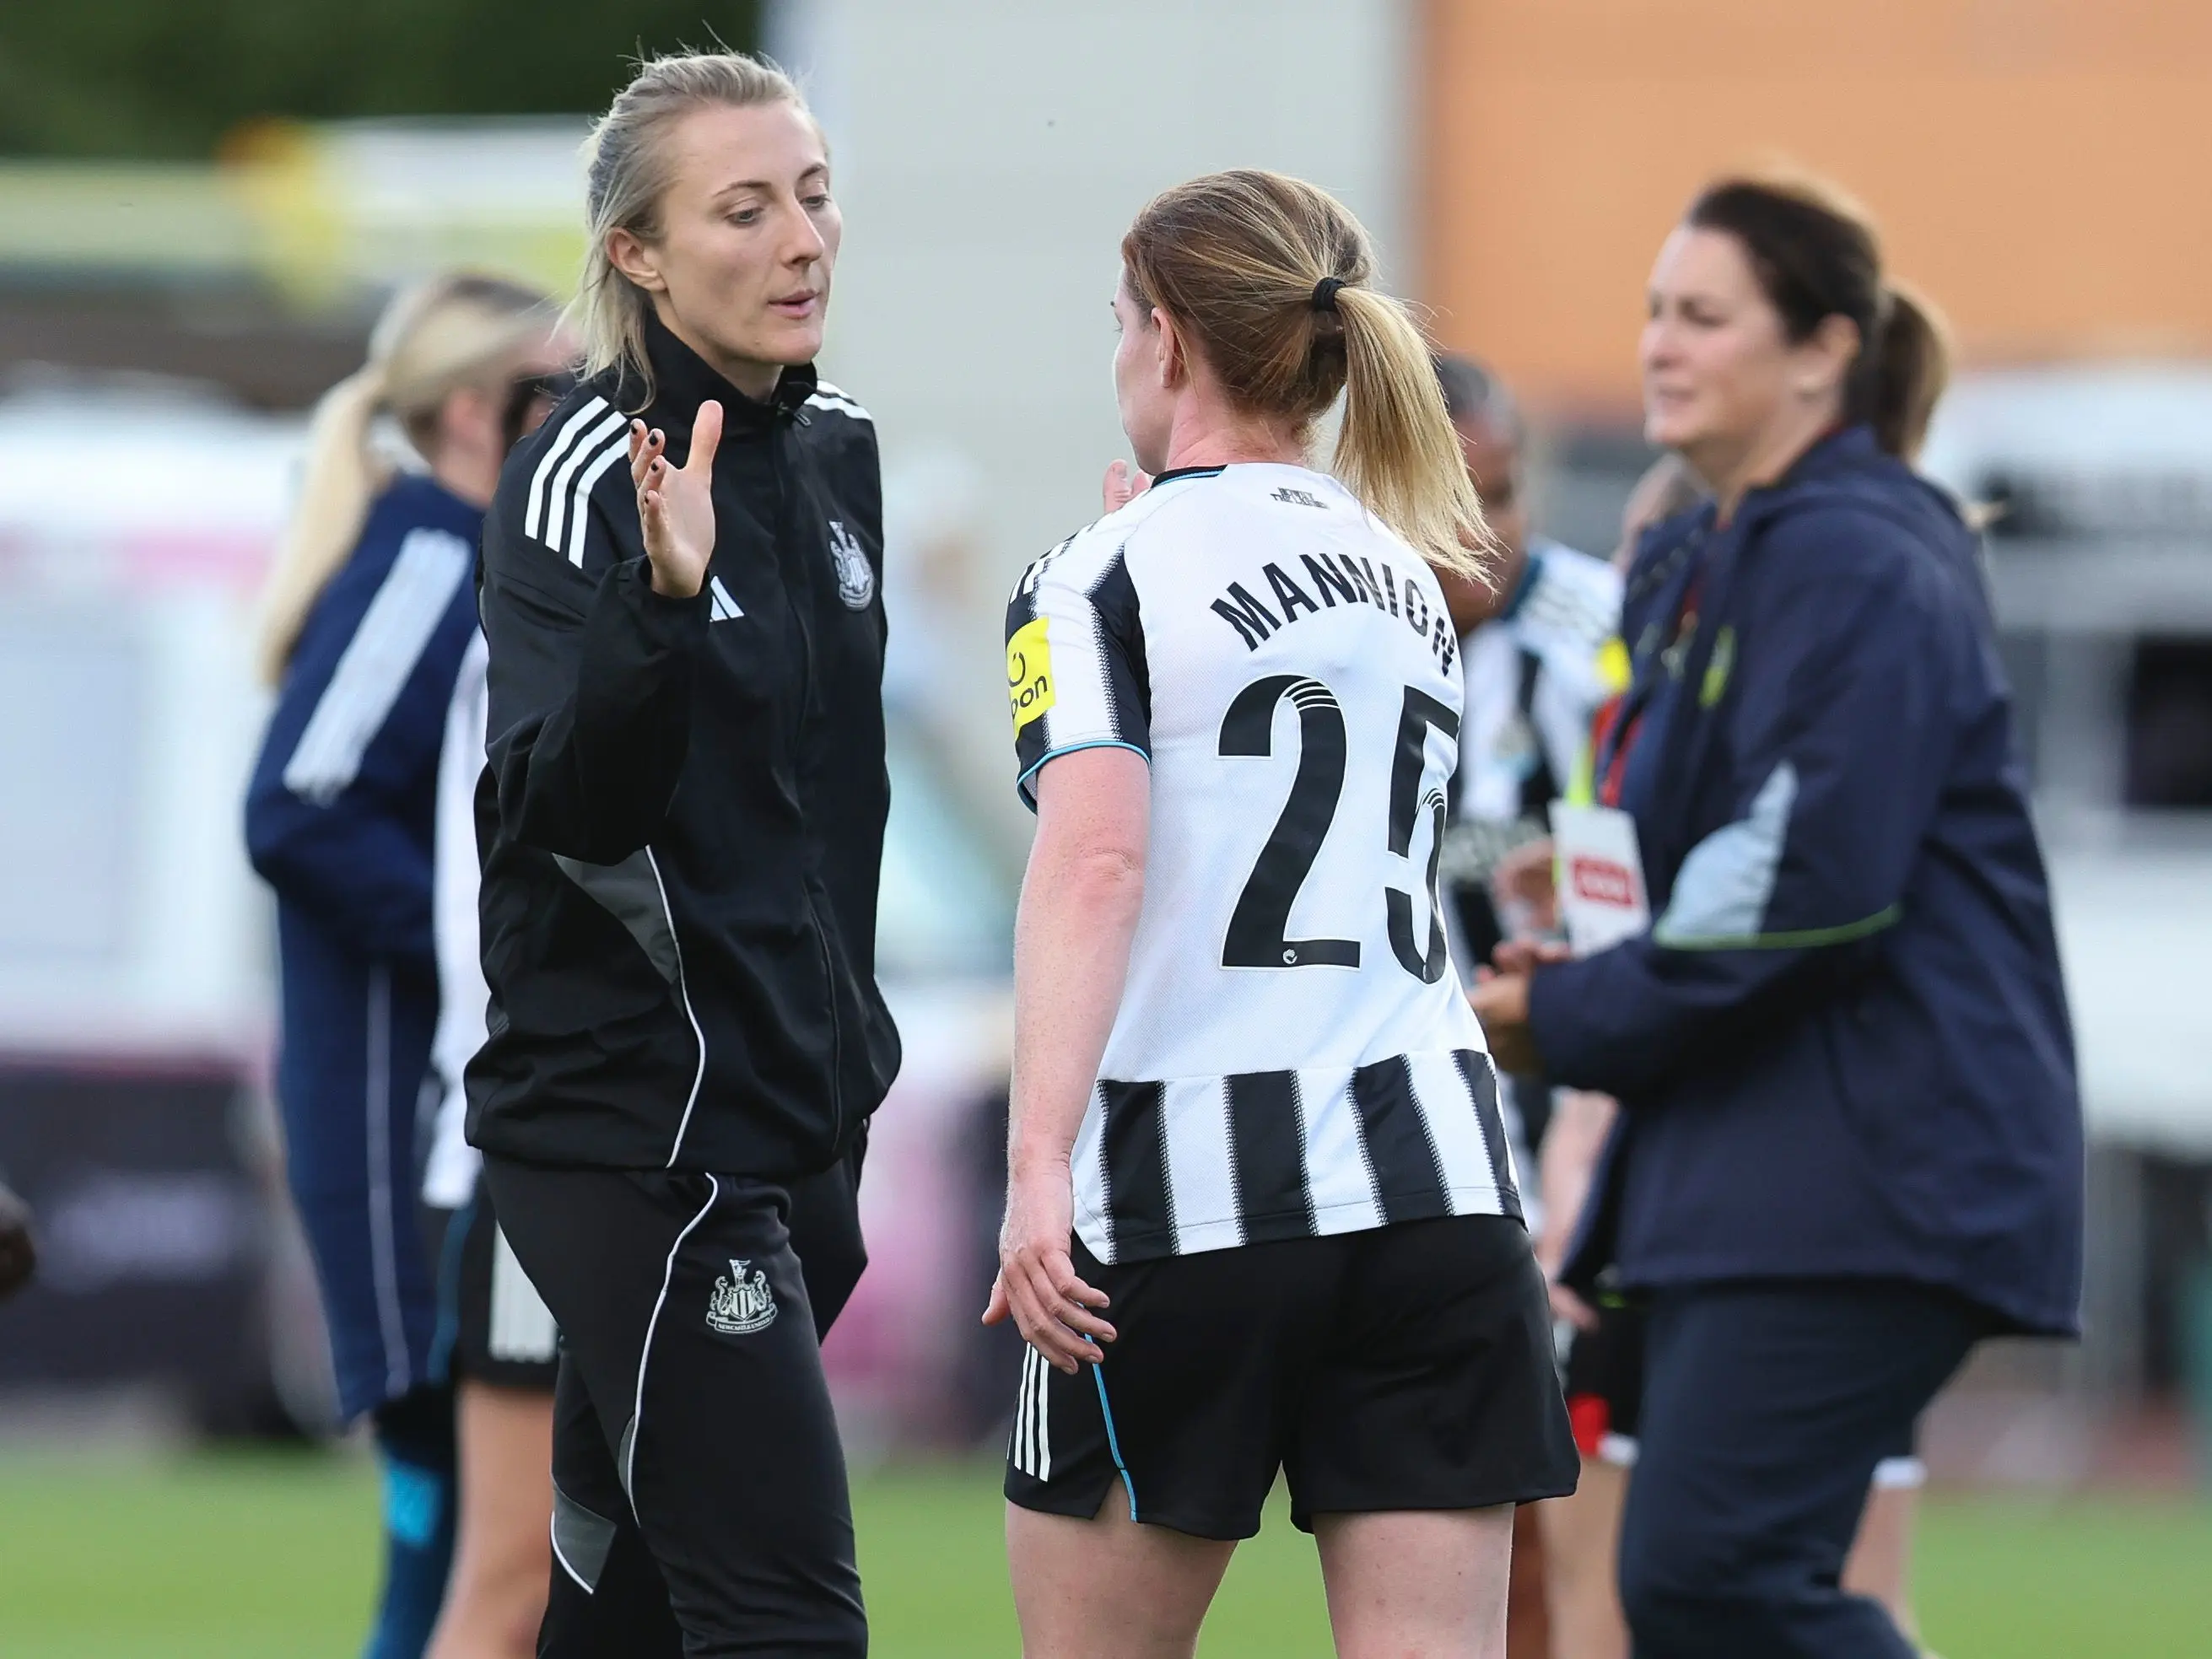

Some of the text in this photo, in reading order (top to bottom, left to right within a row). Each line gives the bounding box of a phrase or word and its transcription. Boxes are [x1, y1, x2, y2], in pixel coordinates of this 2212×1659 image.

[1210, 552, 1455, 677] MANNION
[1011, 675, 1048, 720] oon
[1217, 673, 1461, 985] 25
